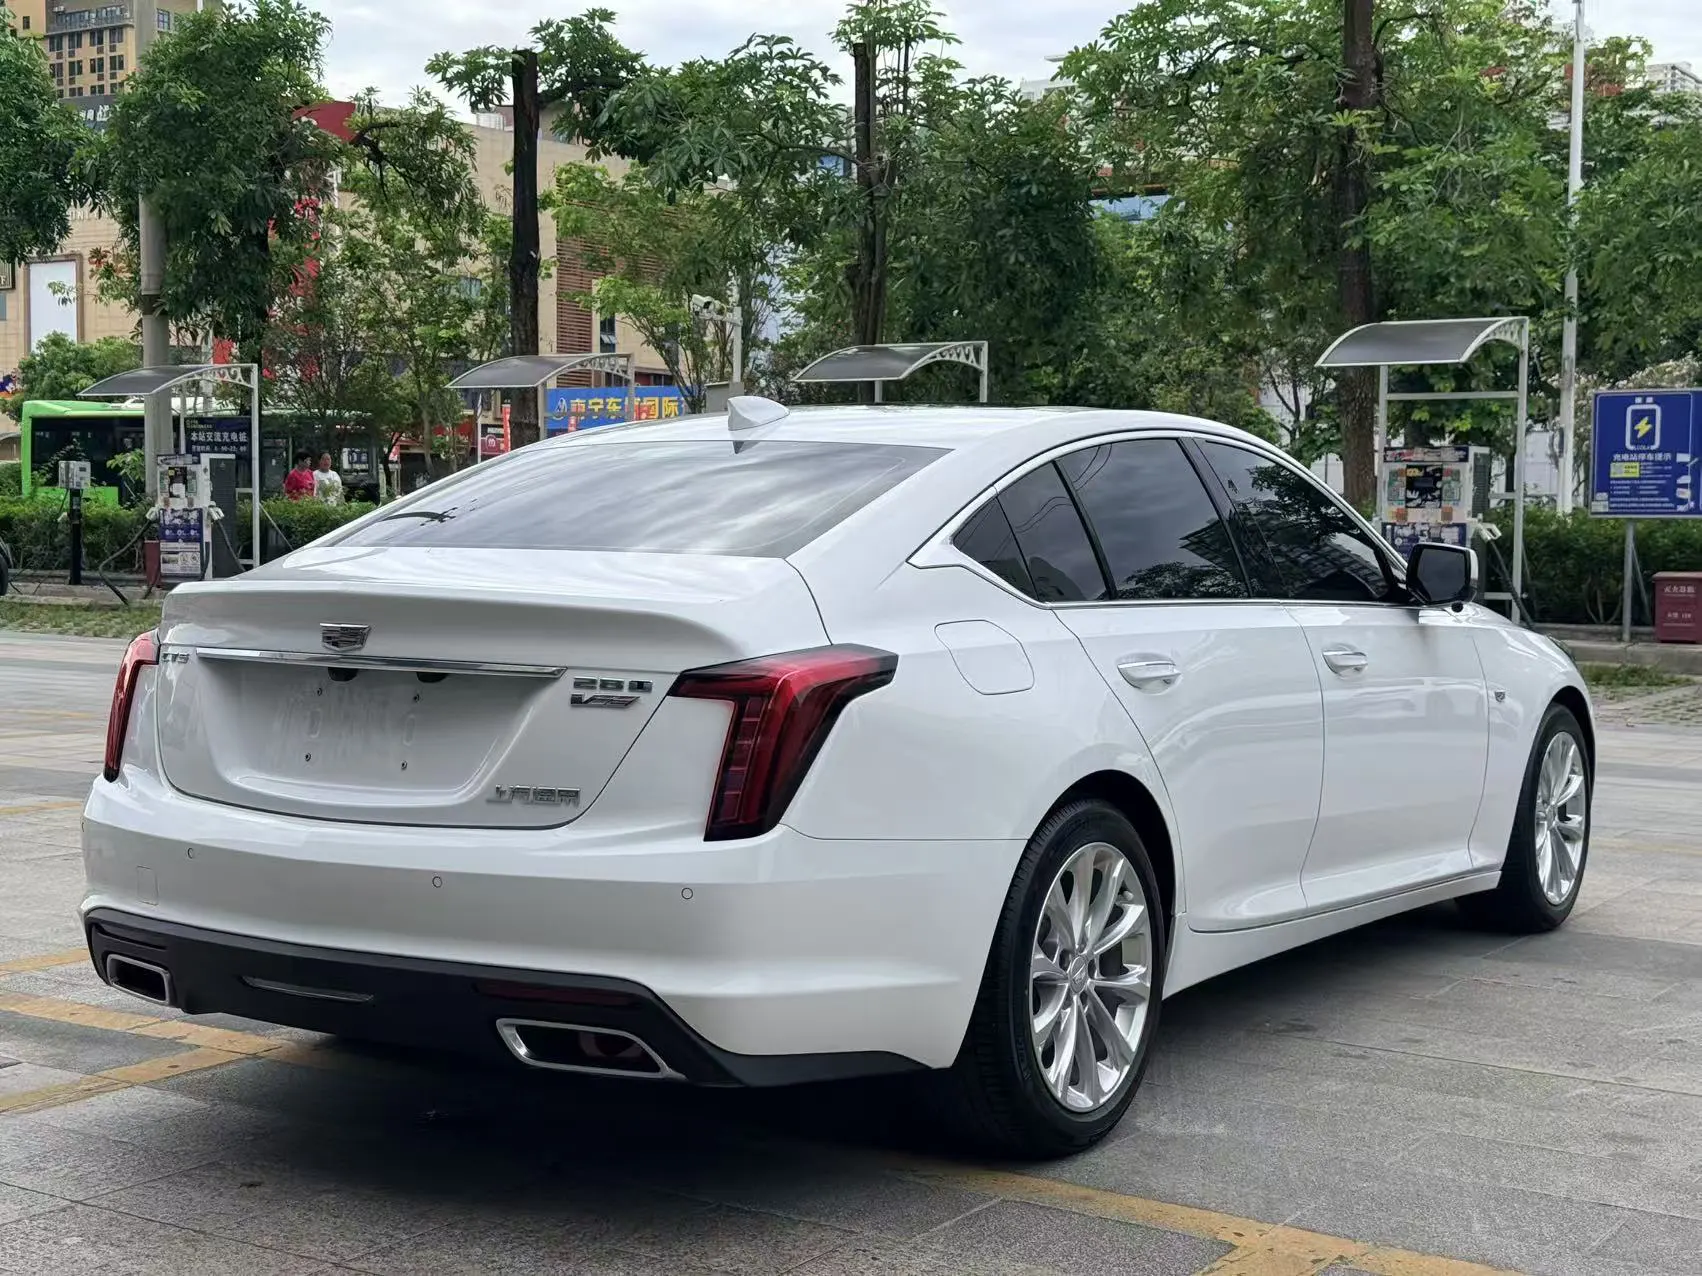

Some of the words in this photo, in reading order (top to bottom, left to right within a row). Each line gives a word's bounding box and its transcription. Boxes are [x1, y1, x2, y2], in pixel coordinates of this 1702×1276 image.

[190, 431, 248, 442] 本站交流充电桩
